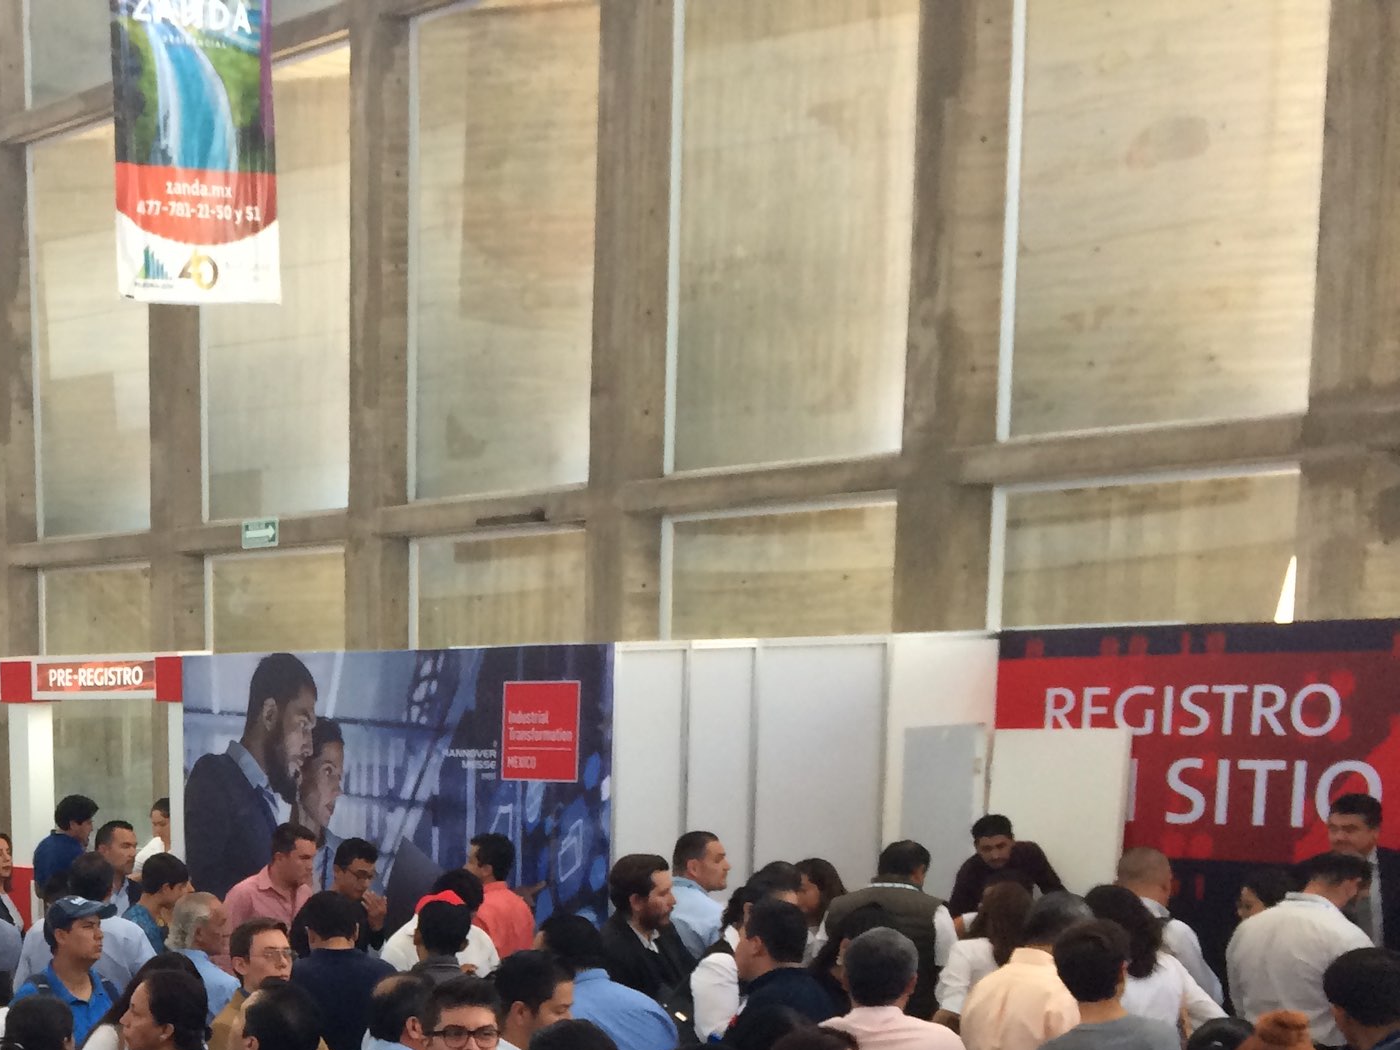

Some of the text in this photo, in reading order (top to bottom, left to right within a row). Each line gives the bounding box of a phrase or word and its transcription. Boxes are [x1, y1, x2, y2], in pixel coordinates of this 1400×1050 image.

[165, 178, 232, 198] zanda.mx
[49, 666, 143, 687] PRE-REGISTRO
[1044, 683, 1342, 737] REGISTRO
[1164, 758, 1382, 828] SITIO
